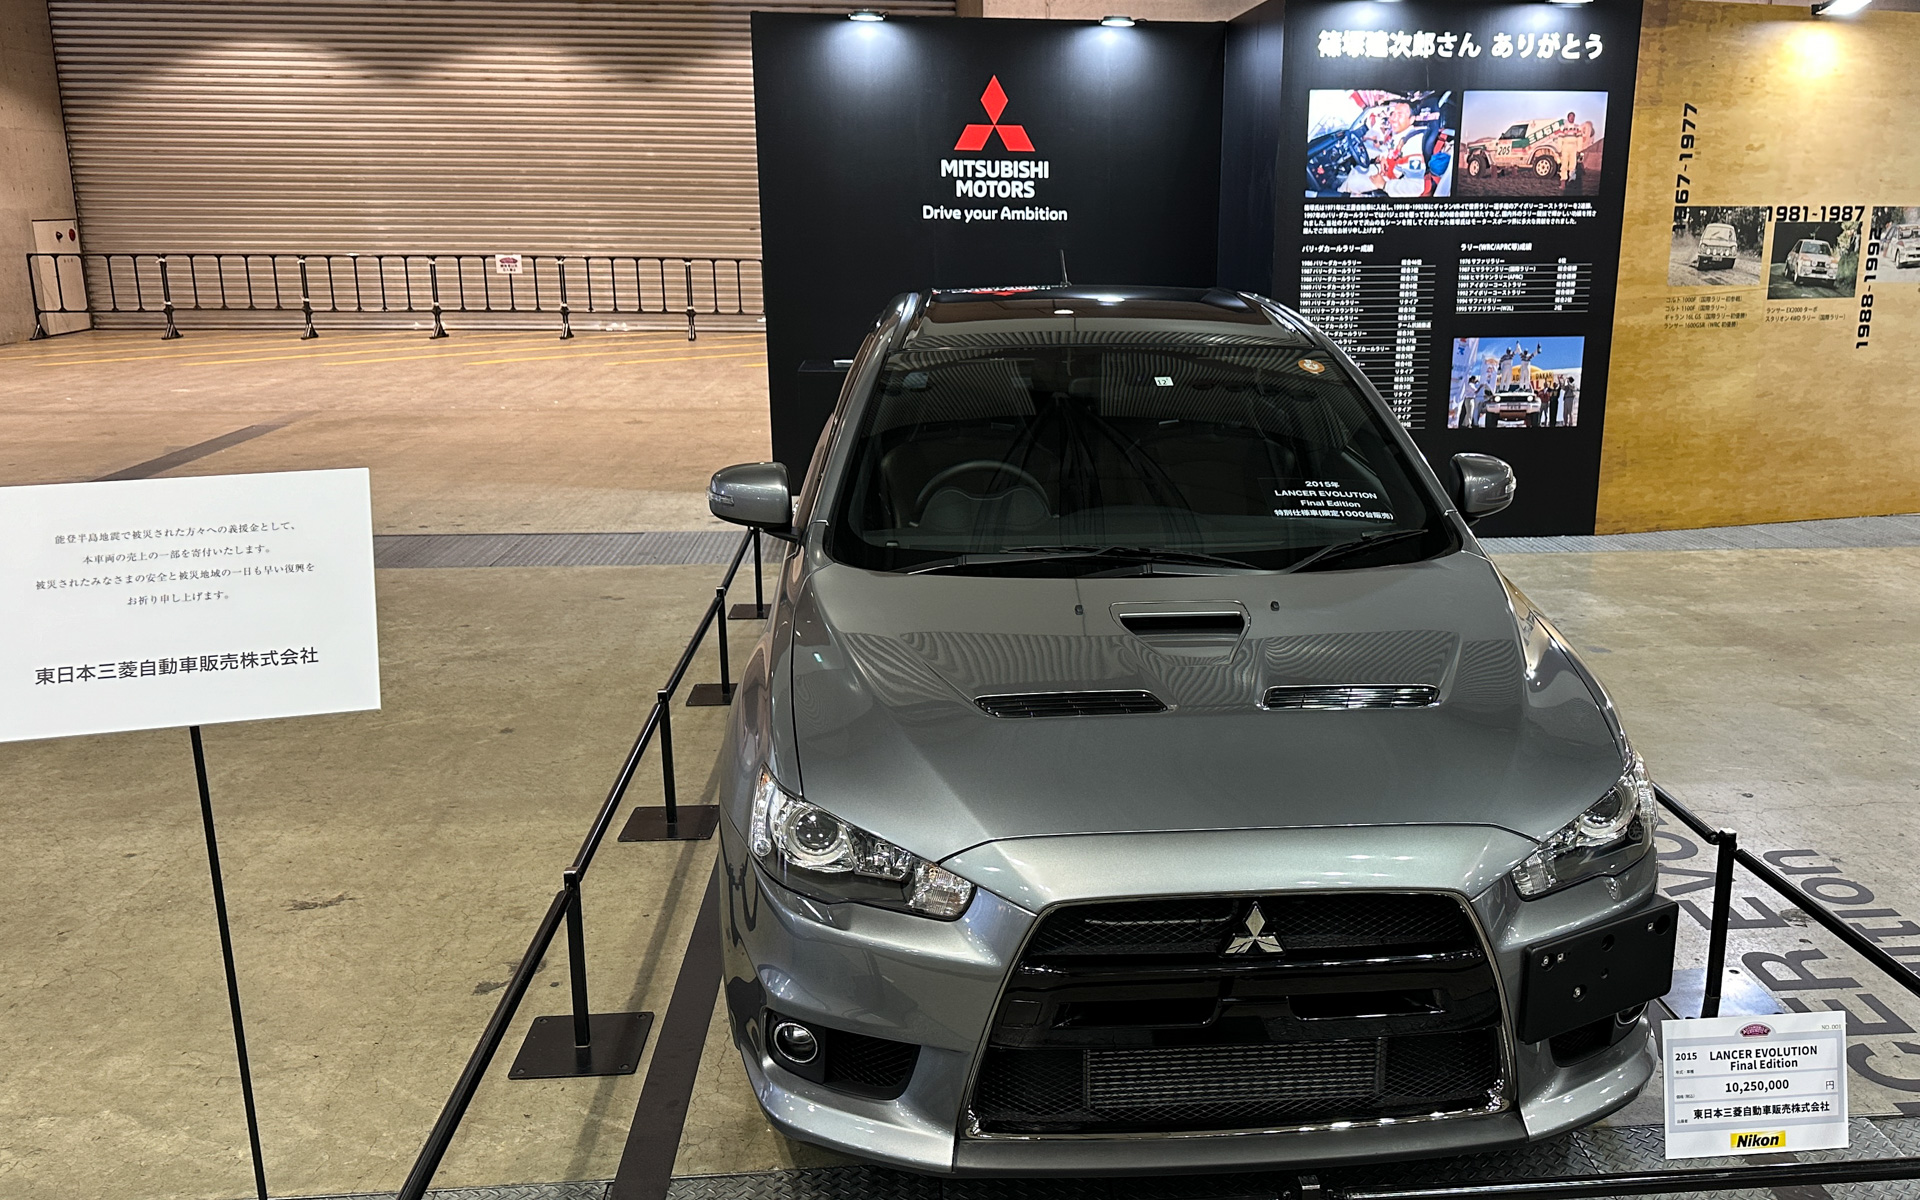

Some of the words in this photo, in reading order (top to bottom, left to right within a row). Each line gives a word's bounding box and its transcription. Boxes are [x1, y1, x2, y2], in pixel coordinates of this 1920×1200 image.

[1491, 32, 1603, 60] ありがとう
[940, 159, 1049, 179] MITSUBISHI
[955, 180, 1035, 199] MOTORS
[922, 205, 962, 220] Drive
[964, 209, 998, 223] your
[1000, 206, 1068, 221] Ambition
[1318, 491, 1378, 499] EVOLUTION
[1326, 500, 1361, 508] Edition
[54, 520, 296, 546] 能登半島地震で被災された方々への義援金として、
[82, 544, 271, 565] 本車両の売上の一部を寄付いたします。
[36, 562, 315, 591] 被災されたみなさまの安全と被災地域の一日も早い復興を
[127, 590, 230, 606] お祈り申し上げます。
[34, 646, 319, 686] 東日本三菱自動車販売株式会社
[1675, 1052, 1698, 1062] 2015
[1710, 1049, 1752, 1061] LANCER
[1755, 1045, 1818, 1059] EVOLUTION
[1730, 1059, 1757, 1071] Final
[1760, 1058, 1798, 1070] Edition
[1725, 1079, 1789, 1094] 10,250,000
[1825, 1080, 1834, 1090] 円
[1693, 1101, 1830, 1120] 東日本三菱自動車販売株式会社
[1736, 1134, 1780, 1148] Nikon
